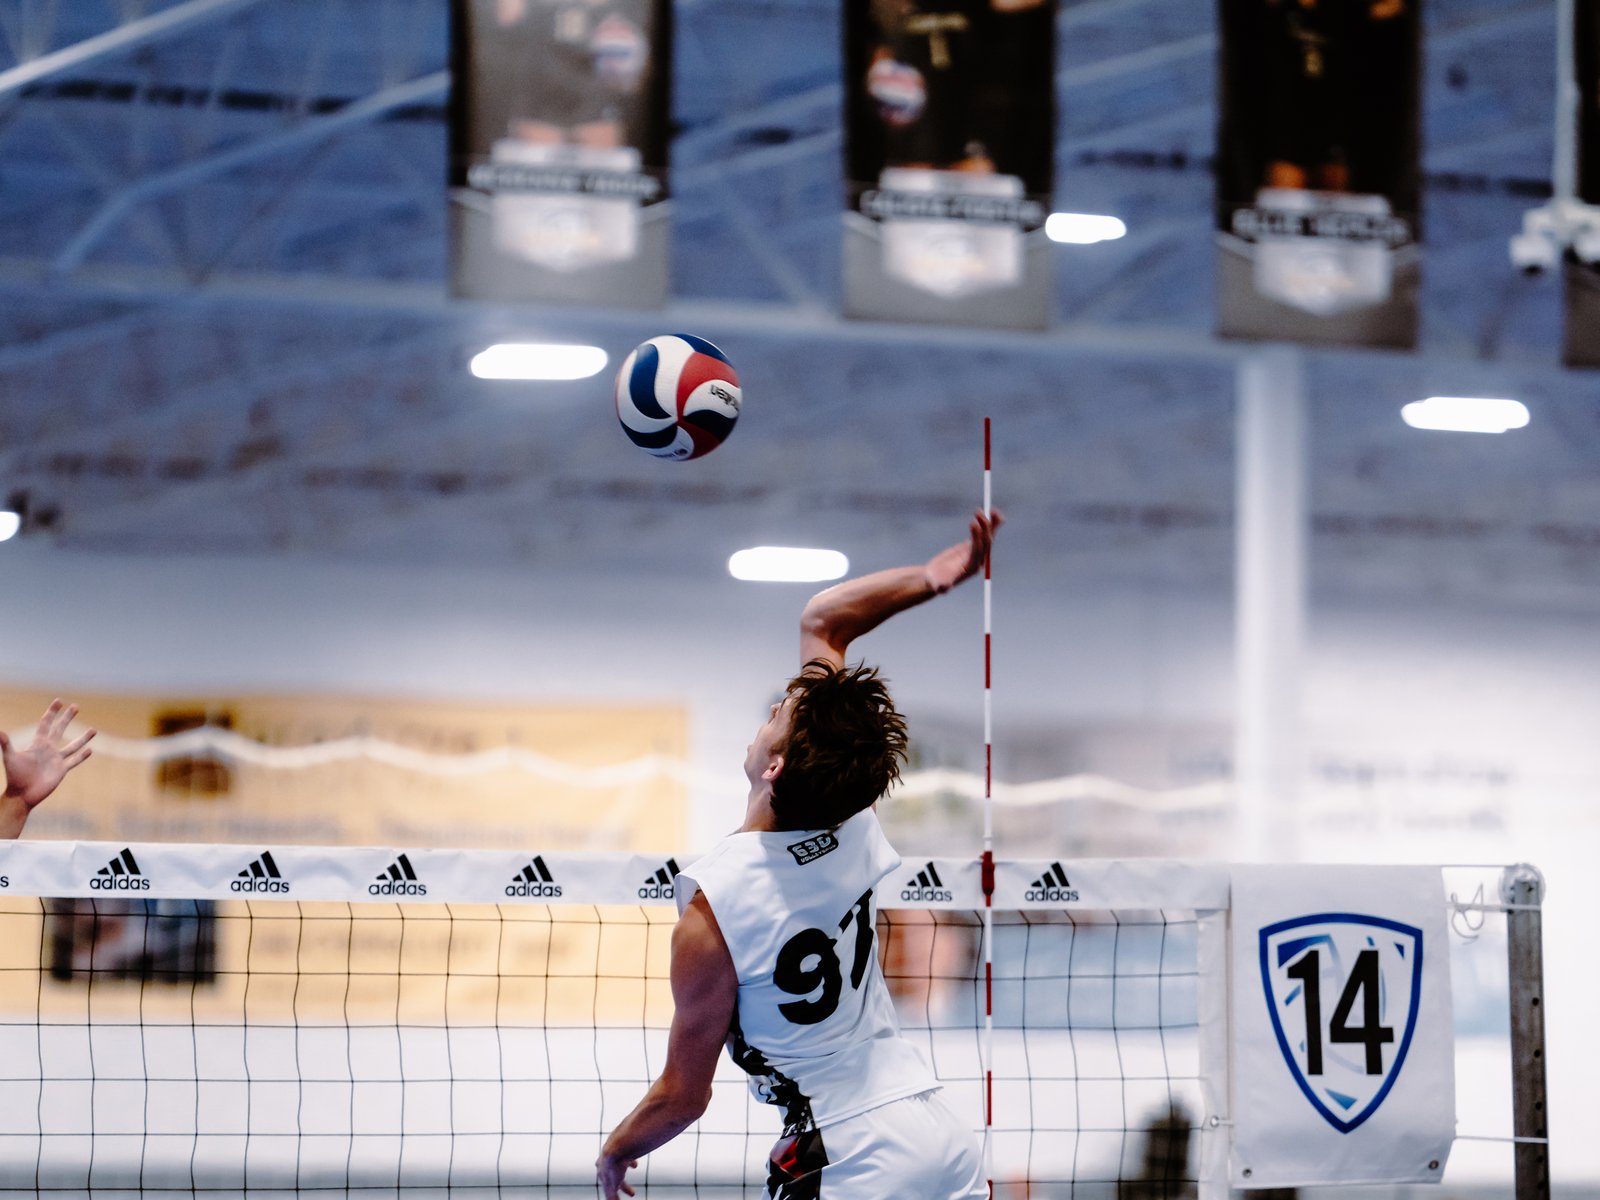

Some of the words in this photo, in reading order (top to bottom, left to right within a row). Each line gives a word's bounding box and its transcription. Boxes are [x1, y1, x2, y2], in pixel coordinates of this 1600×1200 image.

[89, 873, 150, 890] adidas
[230, 876, 290, 893] adidas
[368, 879, 427, 896] adidas
[505, 881, 562, 897] adidas
[638, 883, 676, 900] adid
[901, 886, 953, 902] adidas
[1024, 887, 1080, 902] adidas
[1287, 949, 1395, 1076] 14
